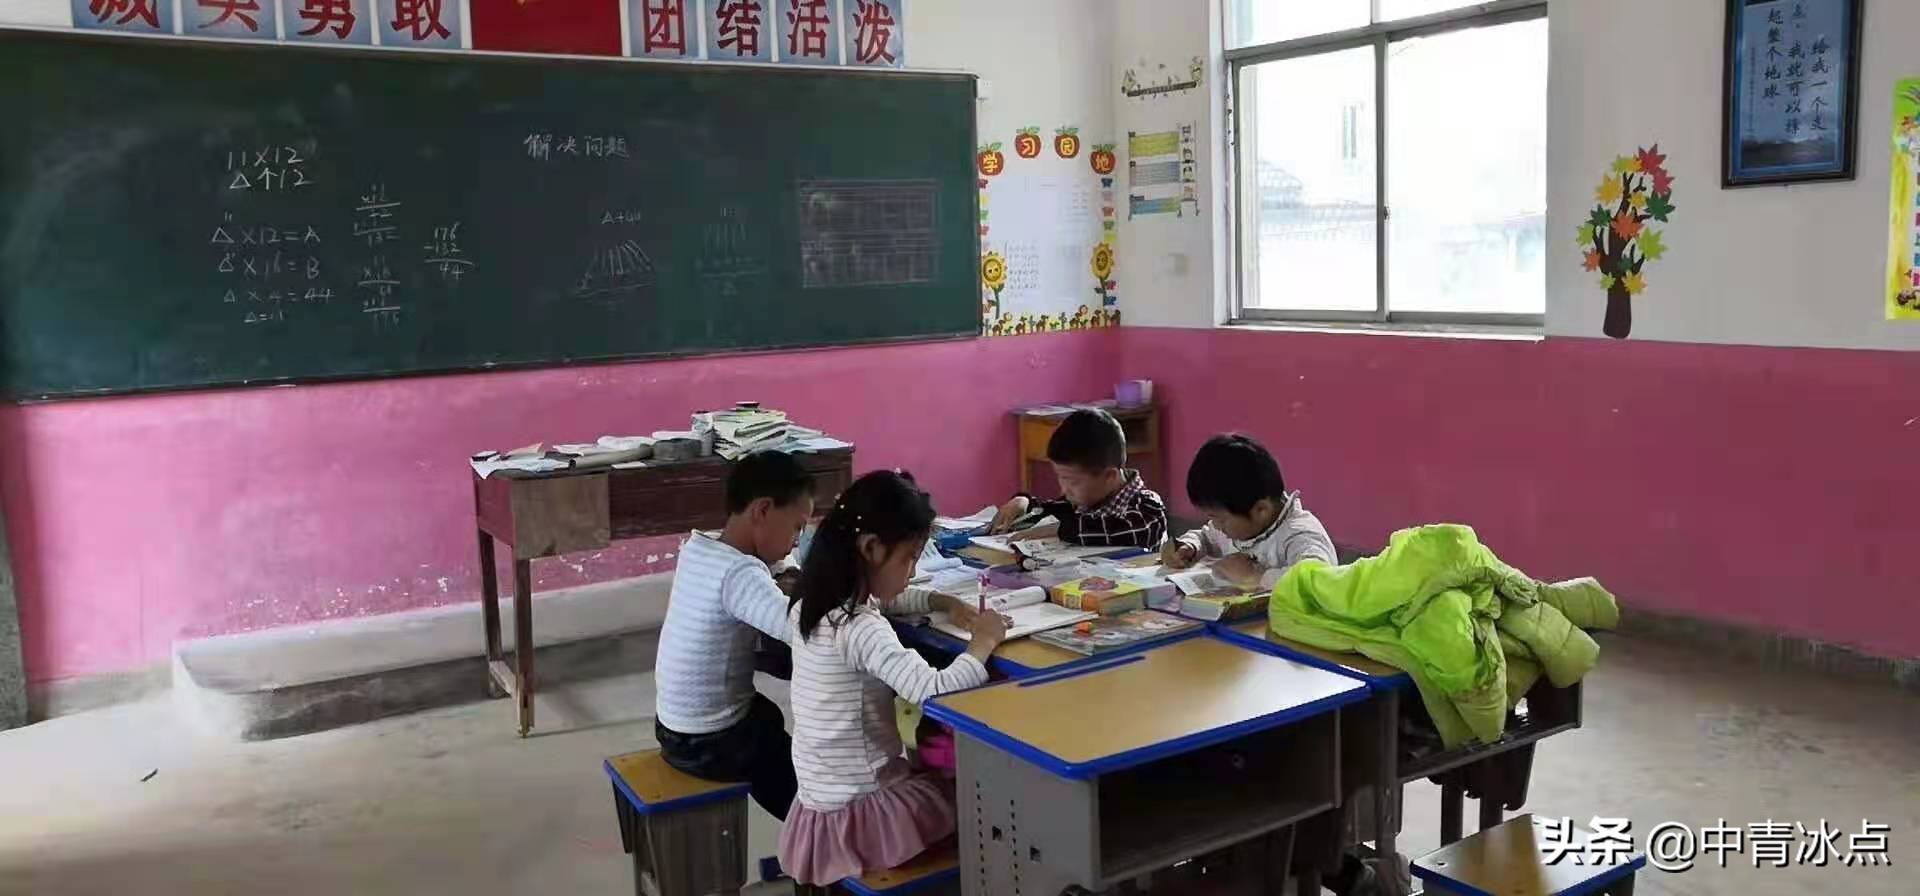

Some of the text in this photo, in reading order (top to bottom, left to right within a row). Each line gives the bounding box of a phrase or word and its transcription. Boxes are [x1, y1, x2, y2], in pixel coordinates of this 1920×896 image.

[643, 0, 898, 64] 团结活泼
[523, 134, 630, 160] 解决问题
